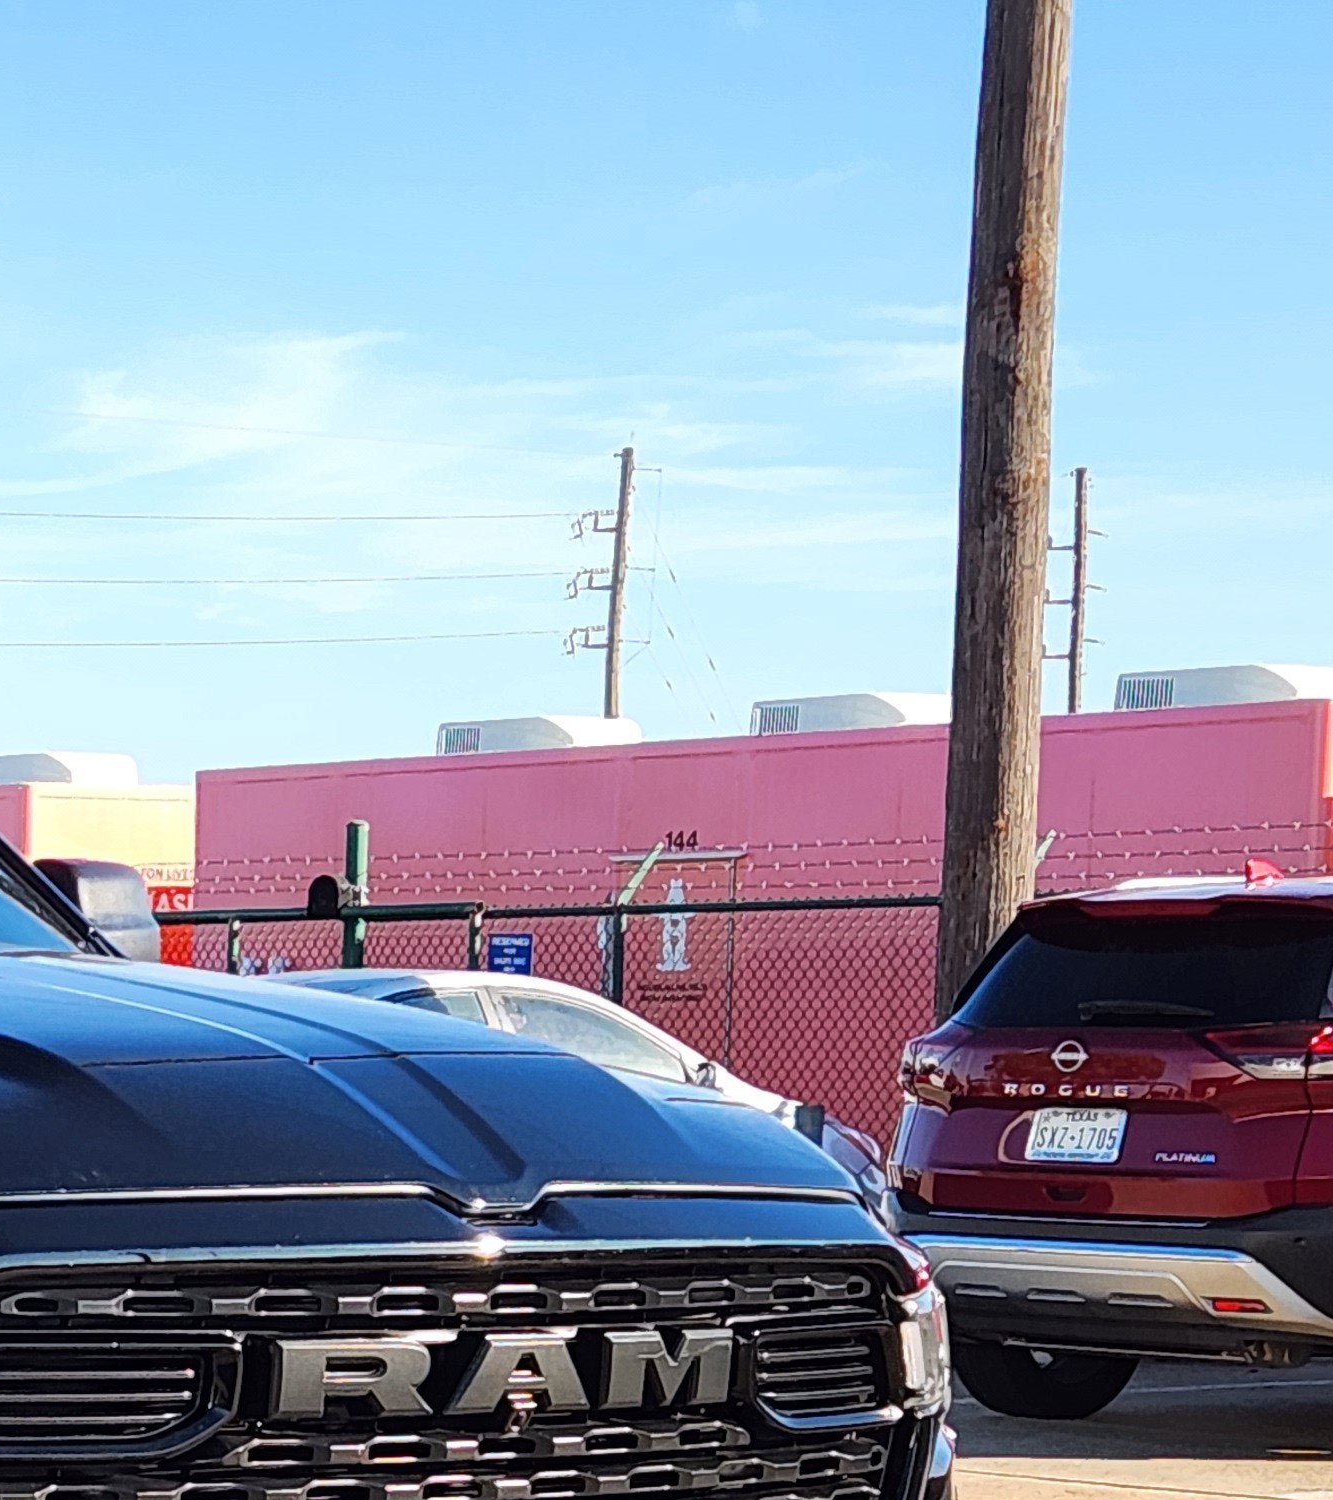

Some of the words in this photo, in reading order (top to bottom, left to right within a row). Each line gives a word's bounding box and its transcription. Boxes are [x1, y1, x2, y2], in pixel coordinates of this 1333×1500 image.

[665, 830, 699, 851] 144
[1001, 1082, 1131, 1098] ROGUE
[1065, 1110, 1099, 1122] TEXAS
[1154, 1152, 1216, 1163] PLATINUM
[271, 1328, 735, 1417] RAM
